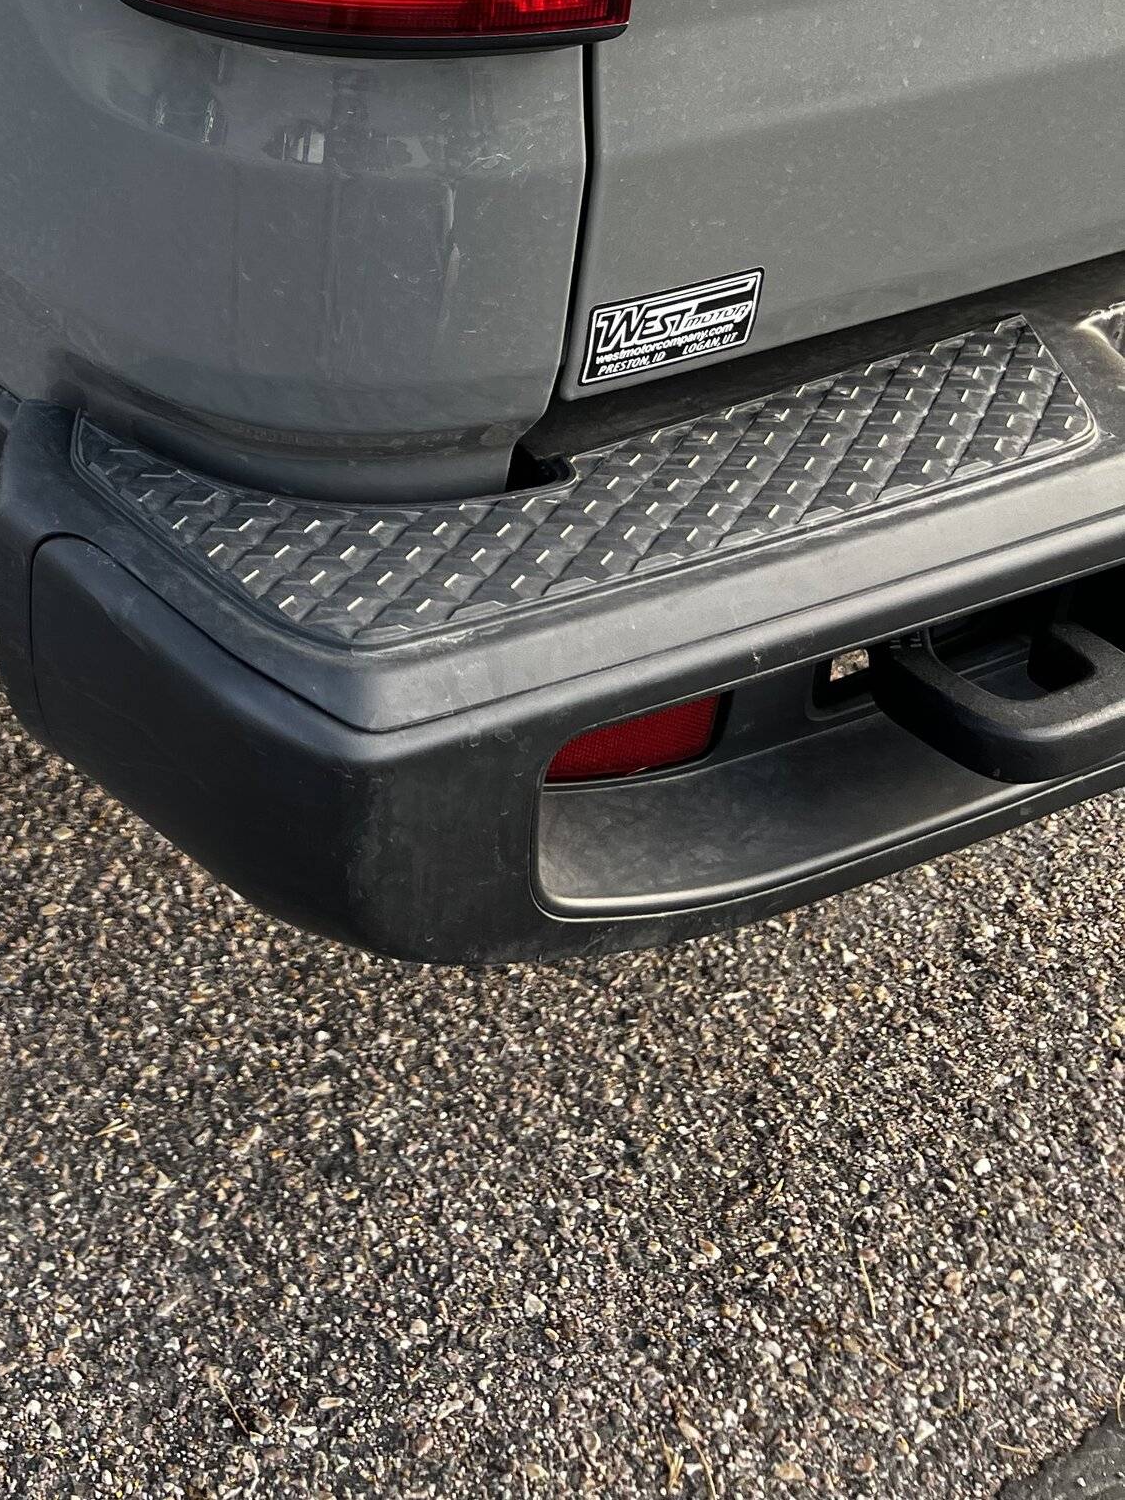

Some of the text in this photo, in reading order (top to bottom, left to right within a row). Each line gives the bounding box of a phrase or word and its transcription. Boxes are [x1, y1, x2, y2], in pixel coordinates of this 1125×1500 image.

[596, 323, 734, 364] westmotorcompany.com
[597, 331, 739, 376] PRESTON, ID LOGAN, UT
